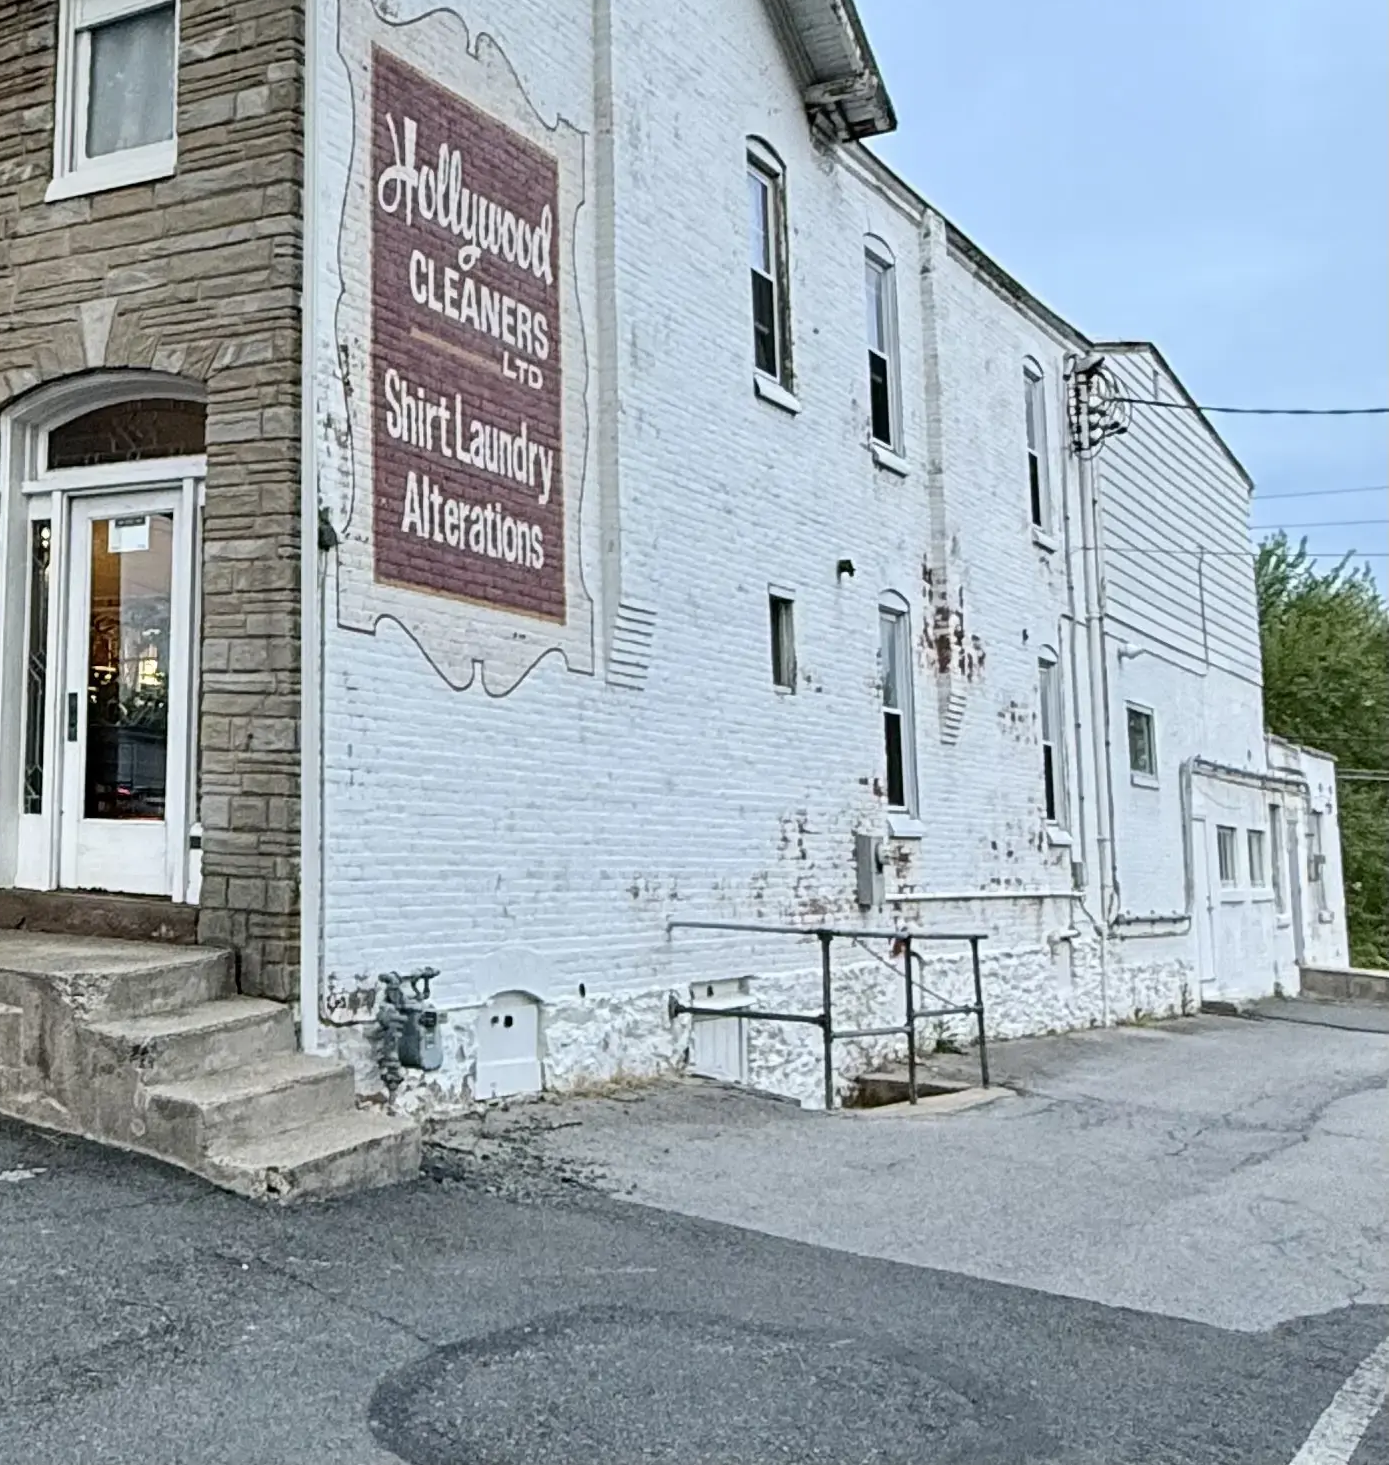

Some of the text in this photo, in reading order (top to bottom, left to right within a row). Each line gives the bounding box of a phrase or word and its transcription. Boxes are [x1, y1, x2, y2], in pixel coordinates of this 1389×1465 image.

[377, 112, 554, 285] Hollywood
[409, 249, 549, 360] CLEANERS
[502, 348, 544, 391] LTD
[383, 367, 554, 506] Shirt Laundry
[401, 469, 545, 570] Alterations
